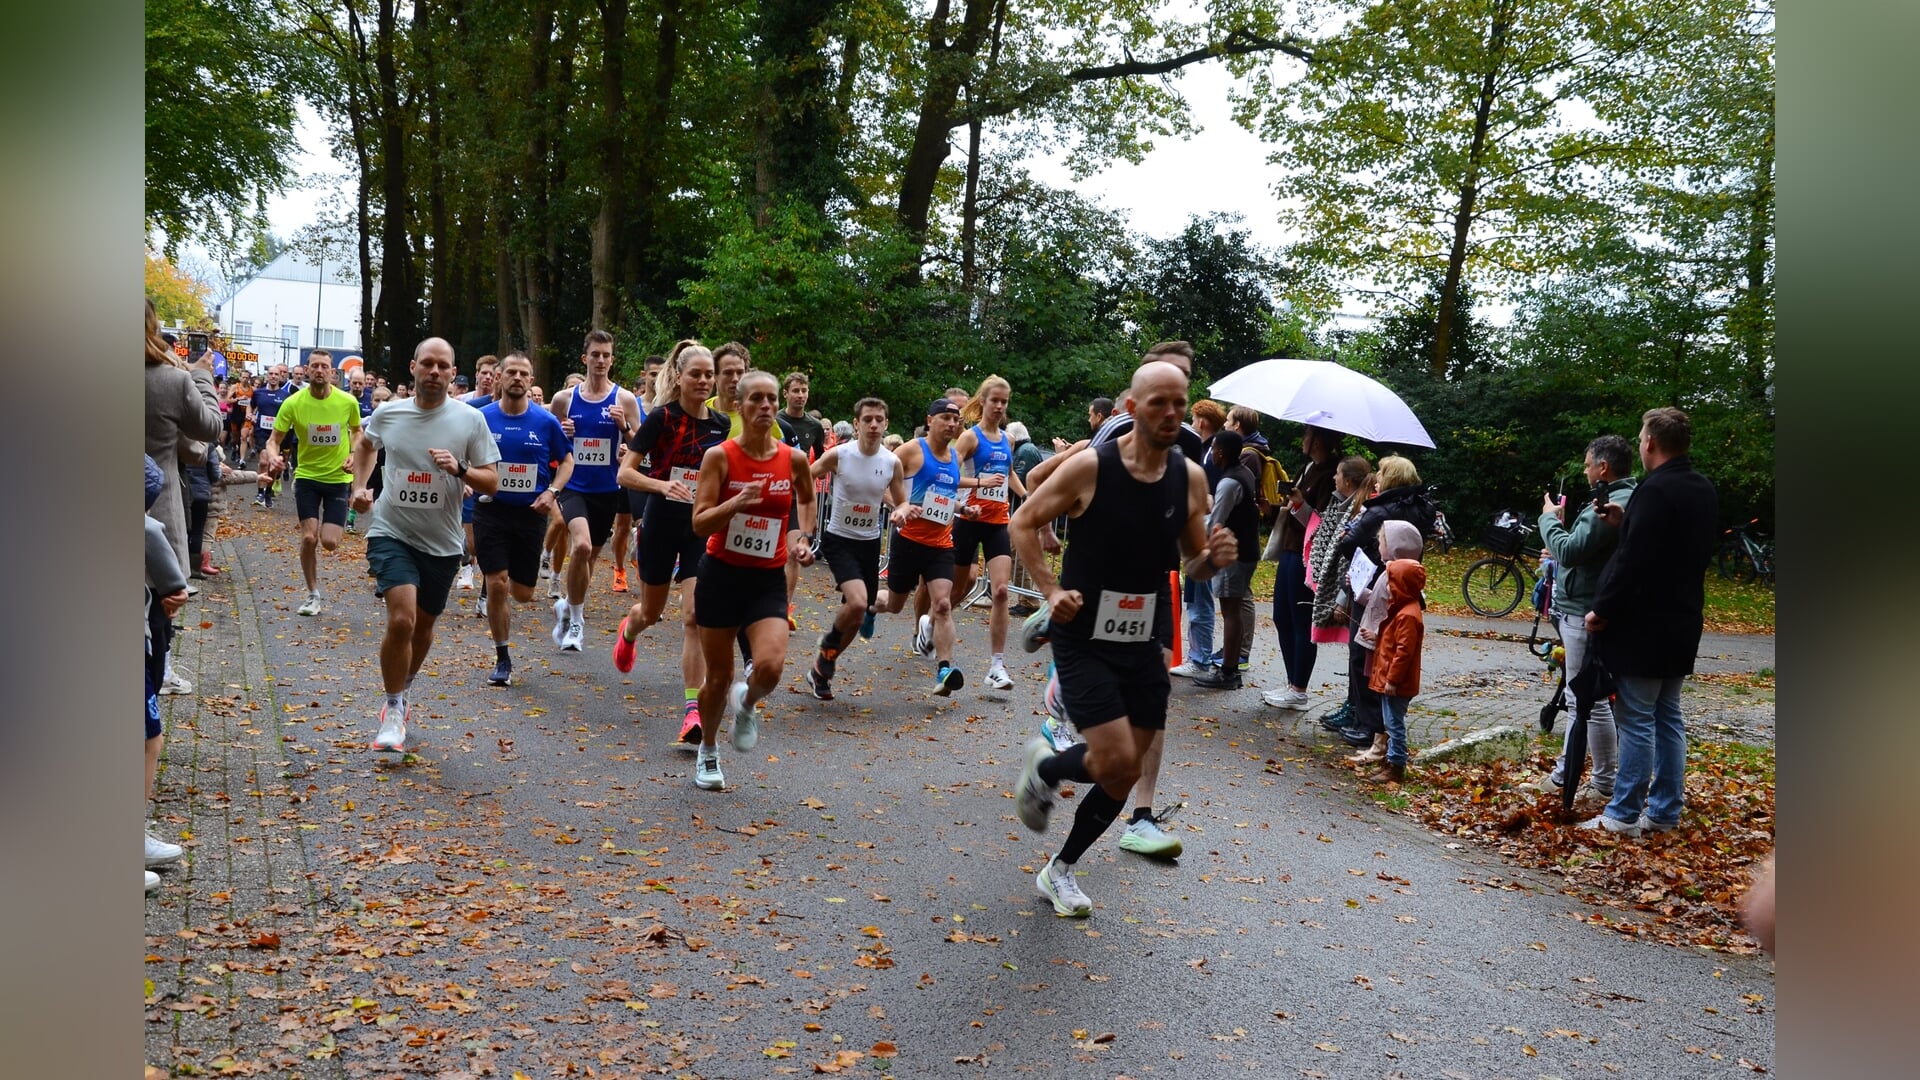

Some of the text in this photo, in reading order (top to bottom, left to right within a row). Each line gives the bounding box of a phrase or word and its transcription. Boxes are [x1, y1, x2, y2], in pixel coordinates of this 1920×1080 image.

[317, 424, 332, 432] dalli
[312, 435, 337, 443] 0639
[583, 439, 600, 447] dalli
[578, 452, 605, 462] 0473
[508, 464, 527, 473] dalli
[407, 471, 432, 484] dalli
[502, 478, 532, 488] 0530
[399, 490, 438, 504] 0356
[982, 487, 1005, 498] 0614
[934, 495, 949, 506] dalli
[853, 504, 871, 514] dalli
[926, 507, 949, 521] 0418
[745, 516, 769, 531] dalli
[844, 516, 873, 527] 0632
[733, 534, 771, 553] 0631
[1118, 595, 1145, 610] dalli
[1104, 619, 1146, 636] 0451
